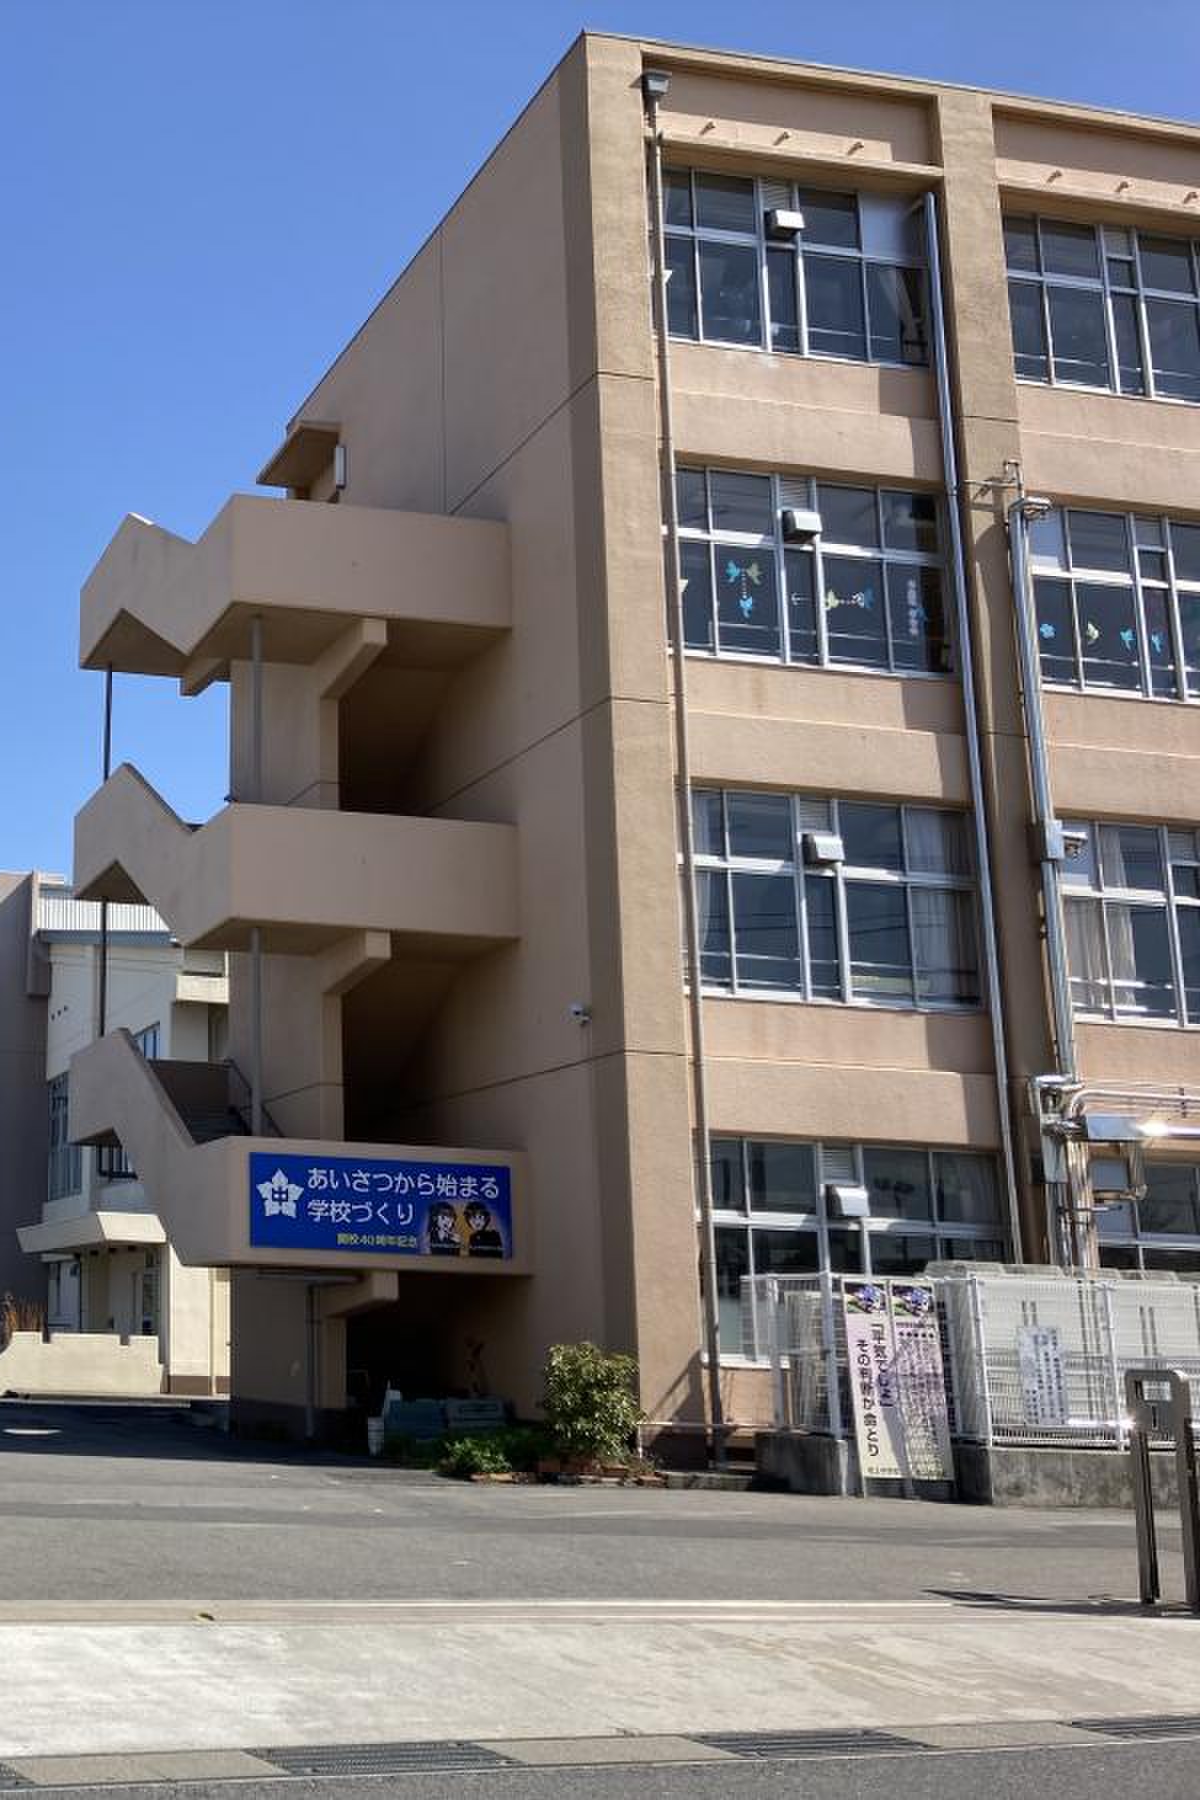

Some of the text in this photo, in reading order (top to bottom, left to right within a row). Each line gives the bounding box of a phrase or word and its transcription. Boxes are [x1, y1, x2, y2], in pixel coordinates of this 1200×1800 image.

[307, 1168, 499, 1199] あいさつから始まる
[307, 1199, 414, 1226] 学校づくり
